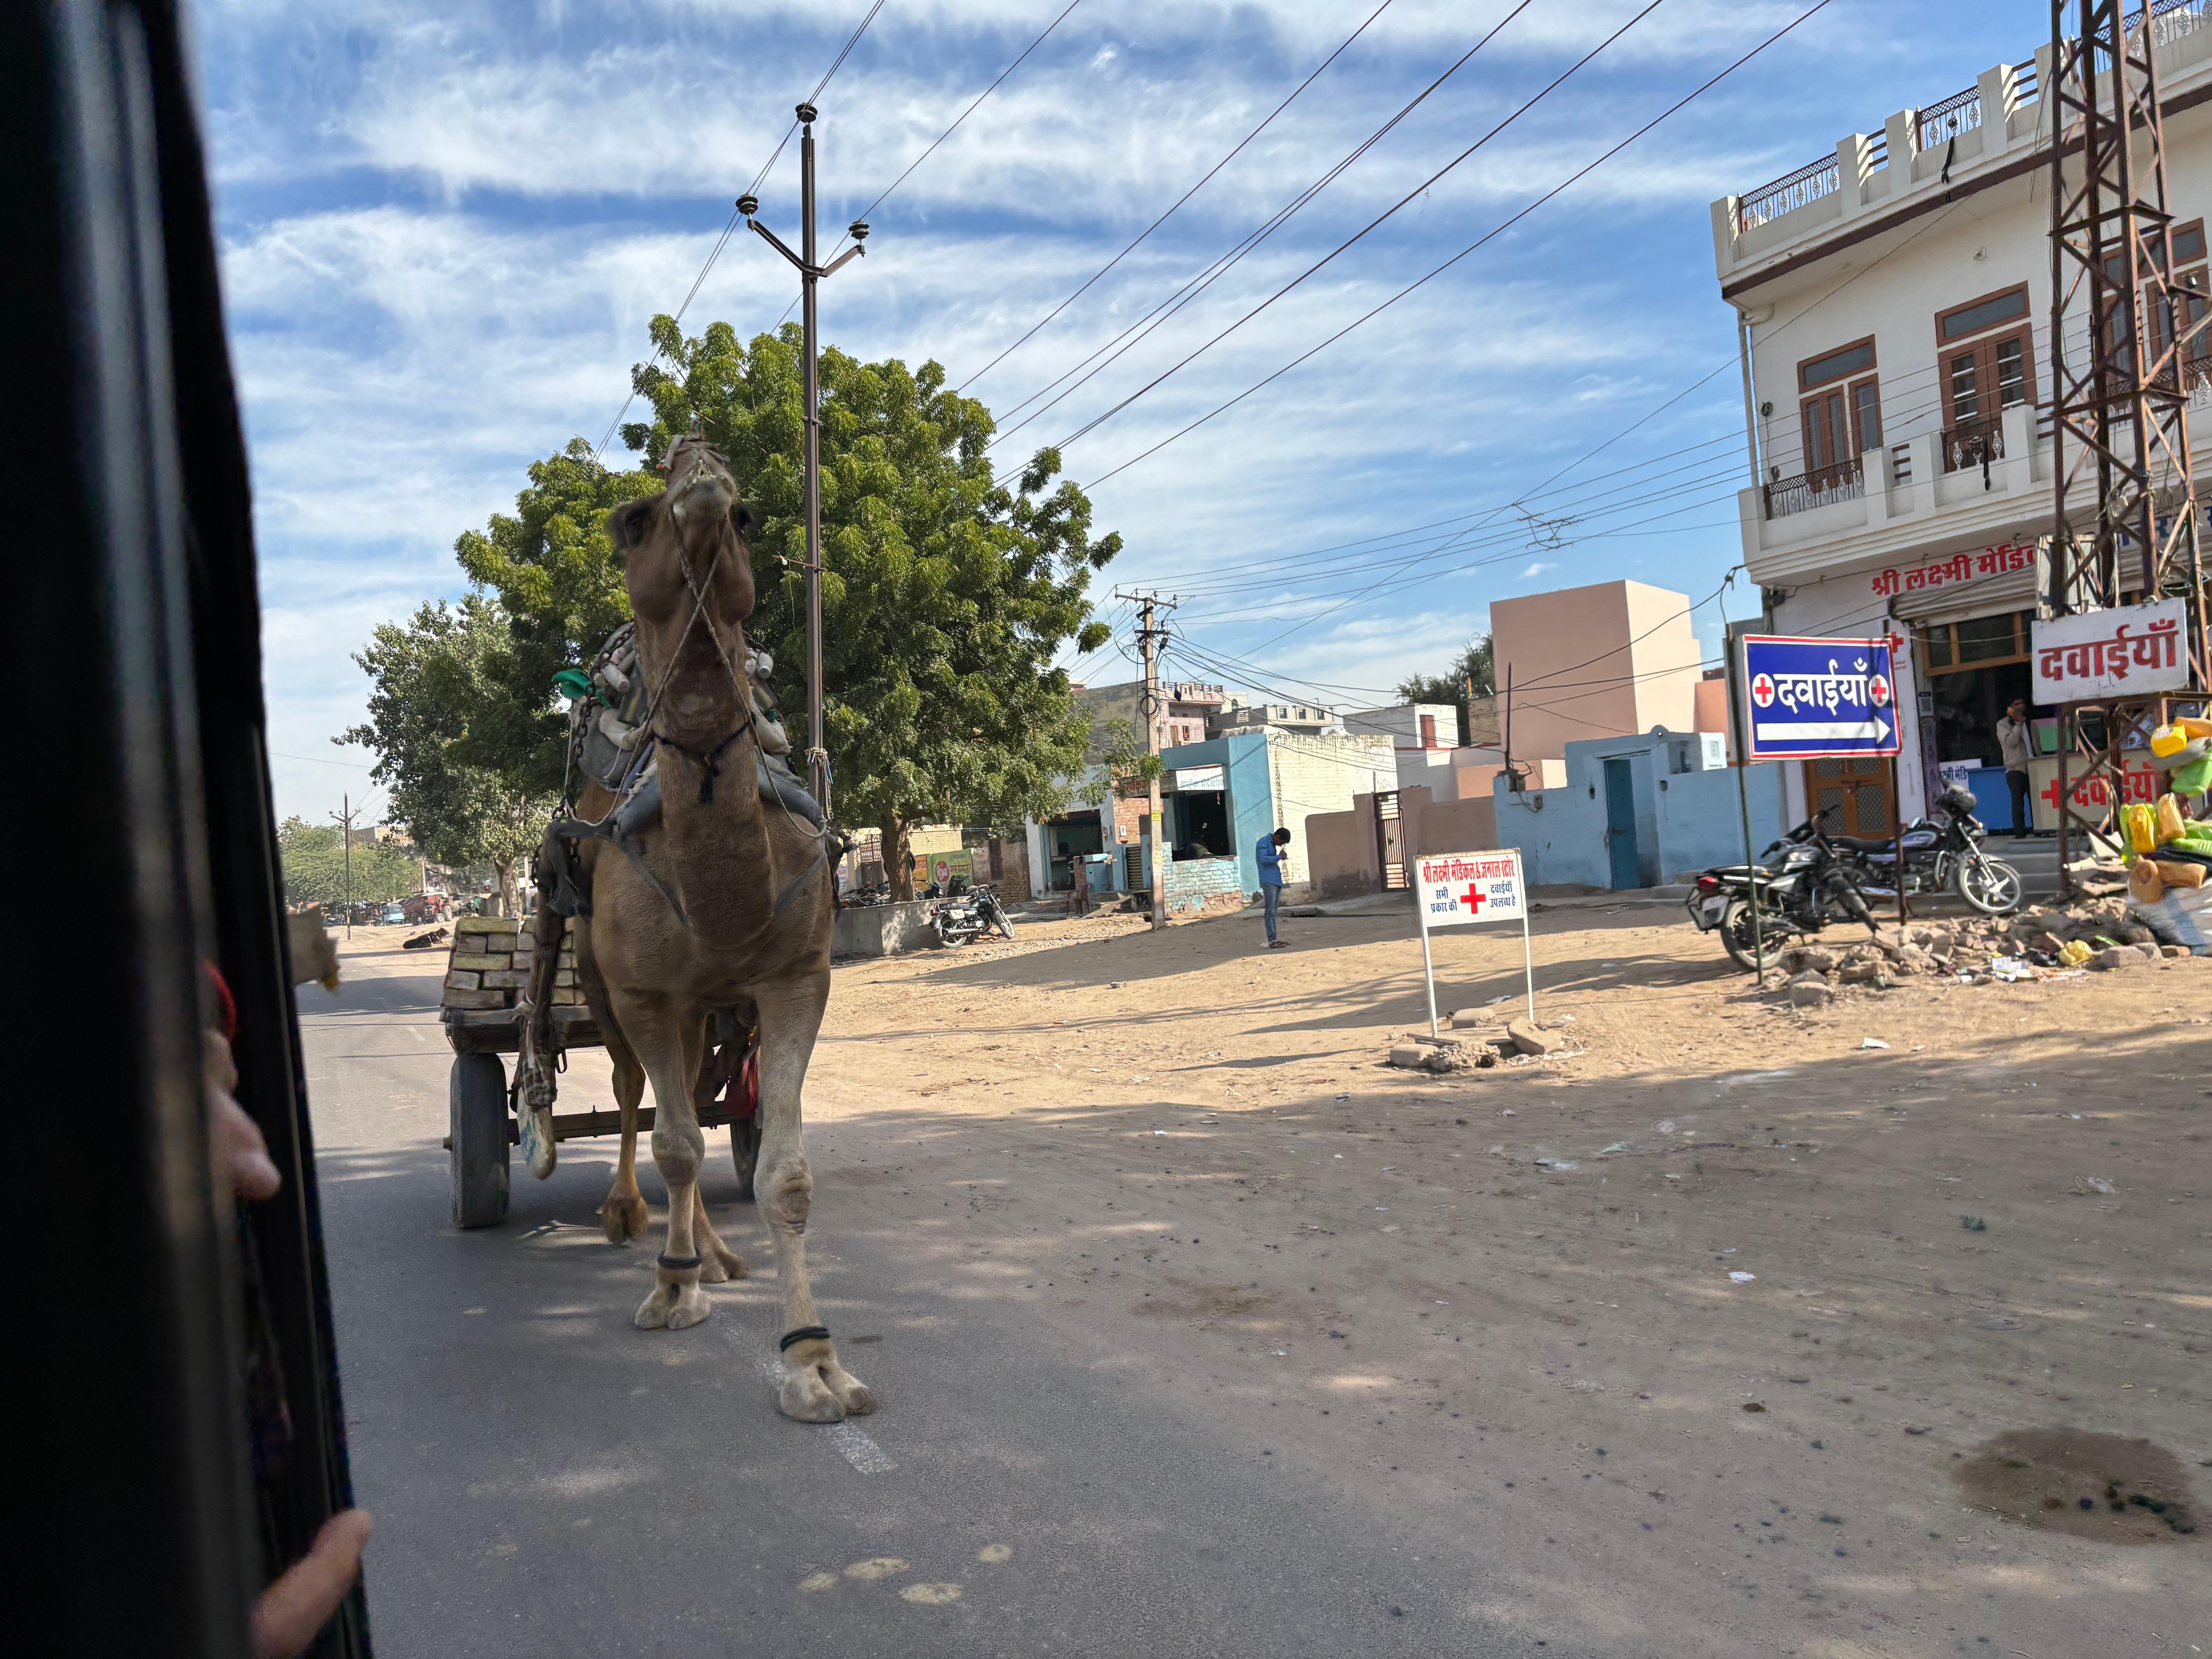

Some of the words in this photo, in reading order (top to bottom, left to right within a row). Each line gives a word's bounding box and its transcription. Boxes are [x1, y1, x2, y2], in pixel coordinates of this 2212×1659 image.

[1871, 569, 1900, 595] श्री
[1904, 554, 1972, 590] लक्ष्मी
[2039, 618, 2179, 681] दवाईयाँ
[1773, 657, 1868, 716] दवाईयाँ
[1423, 861, 1432, 883] श्री
[1451, 859, 1475, 881] मेडिकल
[1475, 862, 1481, 879] &
[1480, 861, 1501, 878] जनरल
[1431, 902, 1447, 913] प्रकार
[1448, 899, 1457, 911] की
[1435, 887, 1449, 899] सभी
